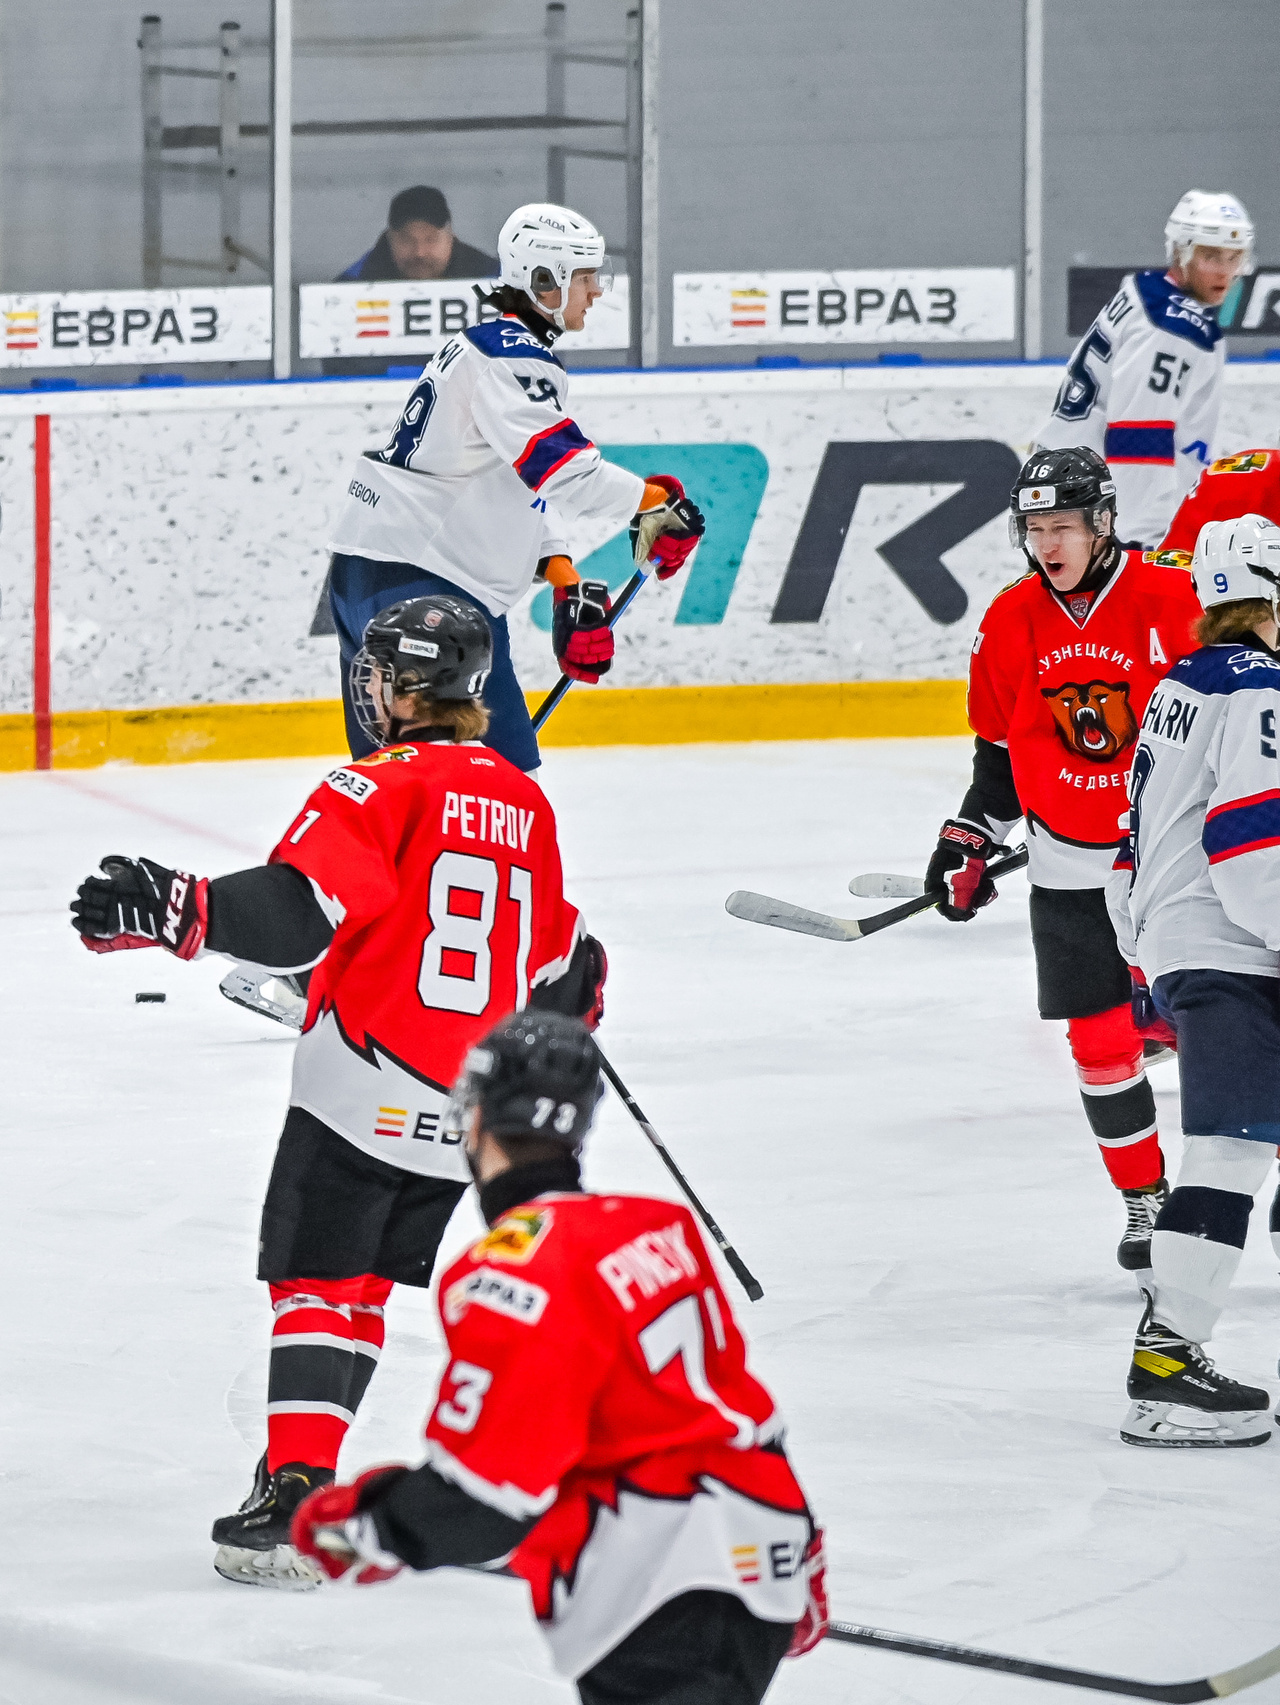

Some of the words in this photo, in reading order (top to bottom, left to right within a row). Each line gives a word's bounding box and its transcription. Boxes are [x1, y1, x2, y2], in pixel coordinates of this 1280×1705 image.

[538, 215, 566, 233] LADA
[402, 297, 504, 337] ЕВР
[779, 287, 958, 327] ЕВРАЗ
[51, 305, 219, 349] ЕВРАЗ
[1028, 464, 1052, 480] 16
[347, 478, 381, 509] EGION
[1212, 572, 1229, 594] 9
[1038, 642, 1134, 675] УЗНЕЦКИЕ
[1149, 627, 1168, 665] A
[1231, 660, 1280, 676] LAD
[328, 770, 369, 797] РАЗ
[1058, 767, 1131, 791] МЕДВЕД
[441, 790, 535, 853] PETROV
[417, 850, 533, 1017] 81
